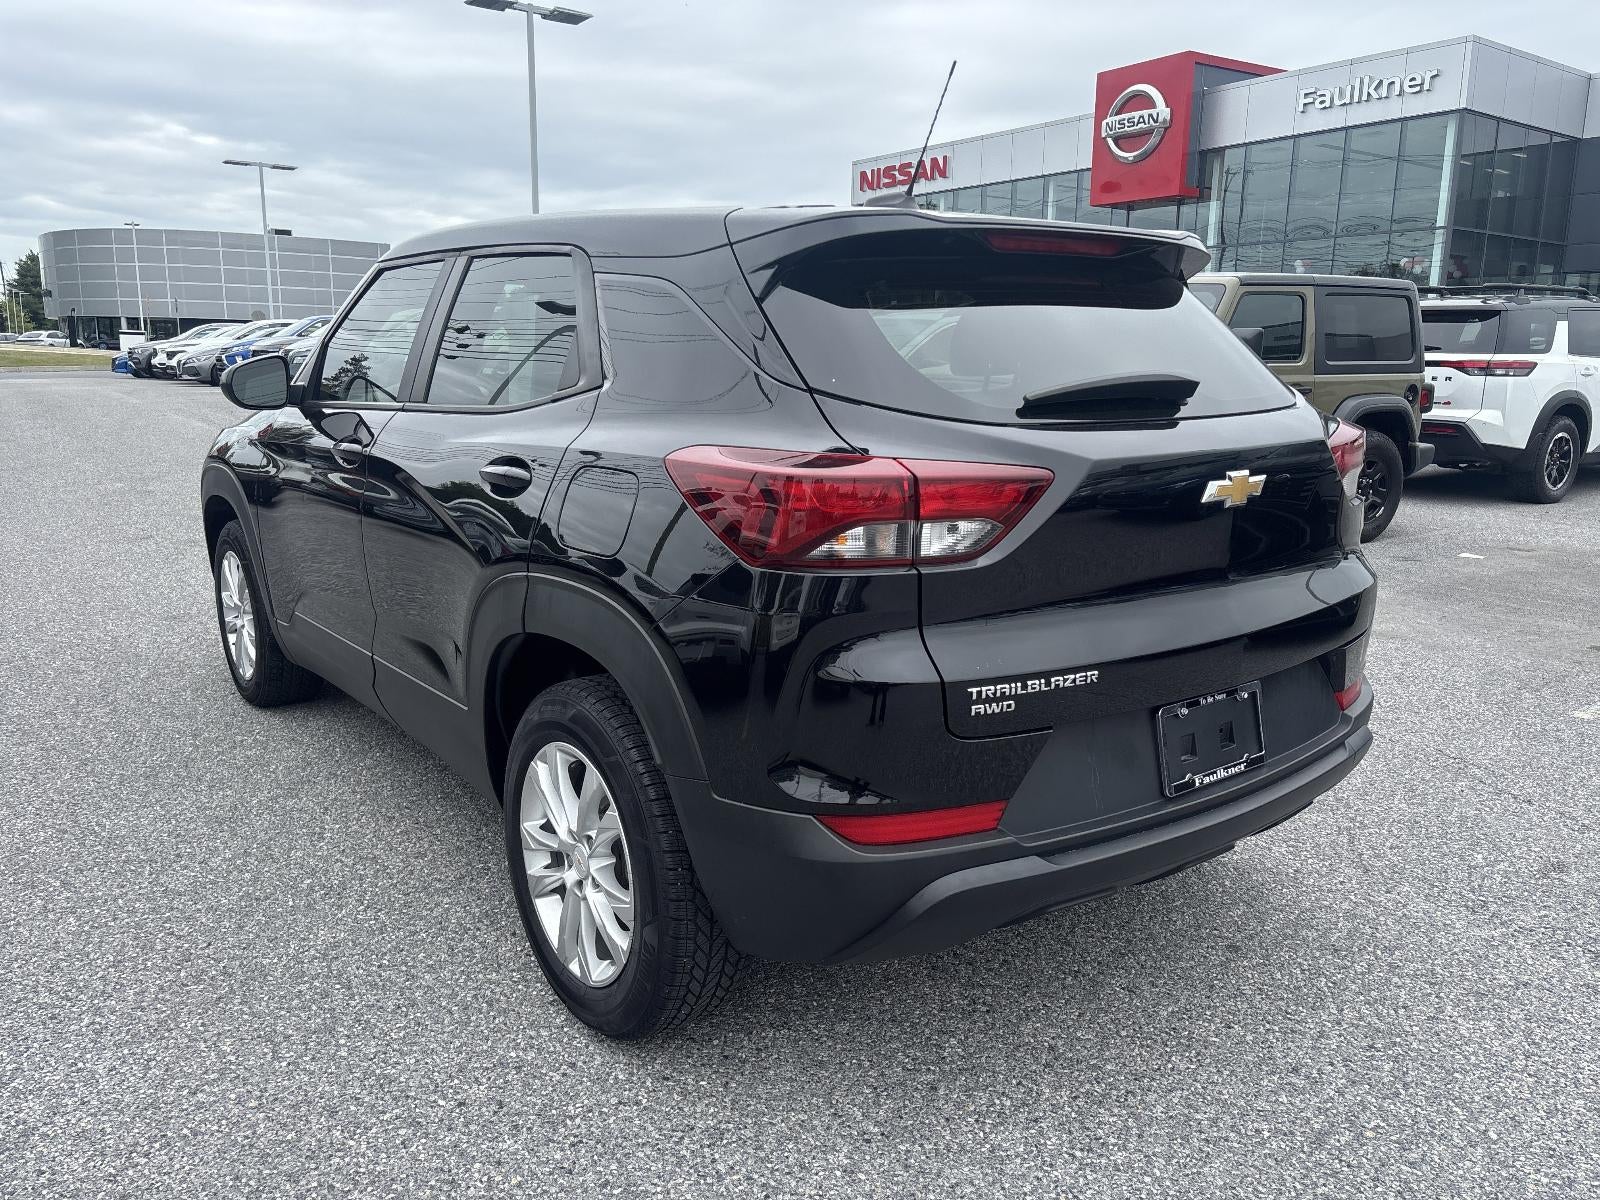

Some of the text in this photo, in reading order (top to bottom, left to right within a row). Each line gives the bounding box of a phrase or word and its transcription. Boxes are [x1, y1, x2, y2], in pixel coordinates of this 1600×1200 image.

[1298, 68, 1440, 112] Faulkner
[1105, 112, 1160, 133] NISSAN
[860, 155, 949, 192] NISSAN
[967, 671, 1099, 700] TRAILBLAZER
[970, 700, 1016, 717] AWD
[1199, 698, 1207, 706] To
[1207, 695, 1214, 704] Be
[1195, 763, 1247, 787] Faulkner
